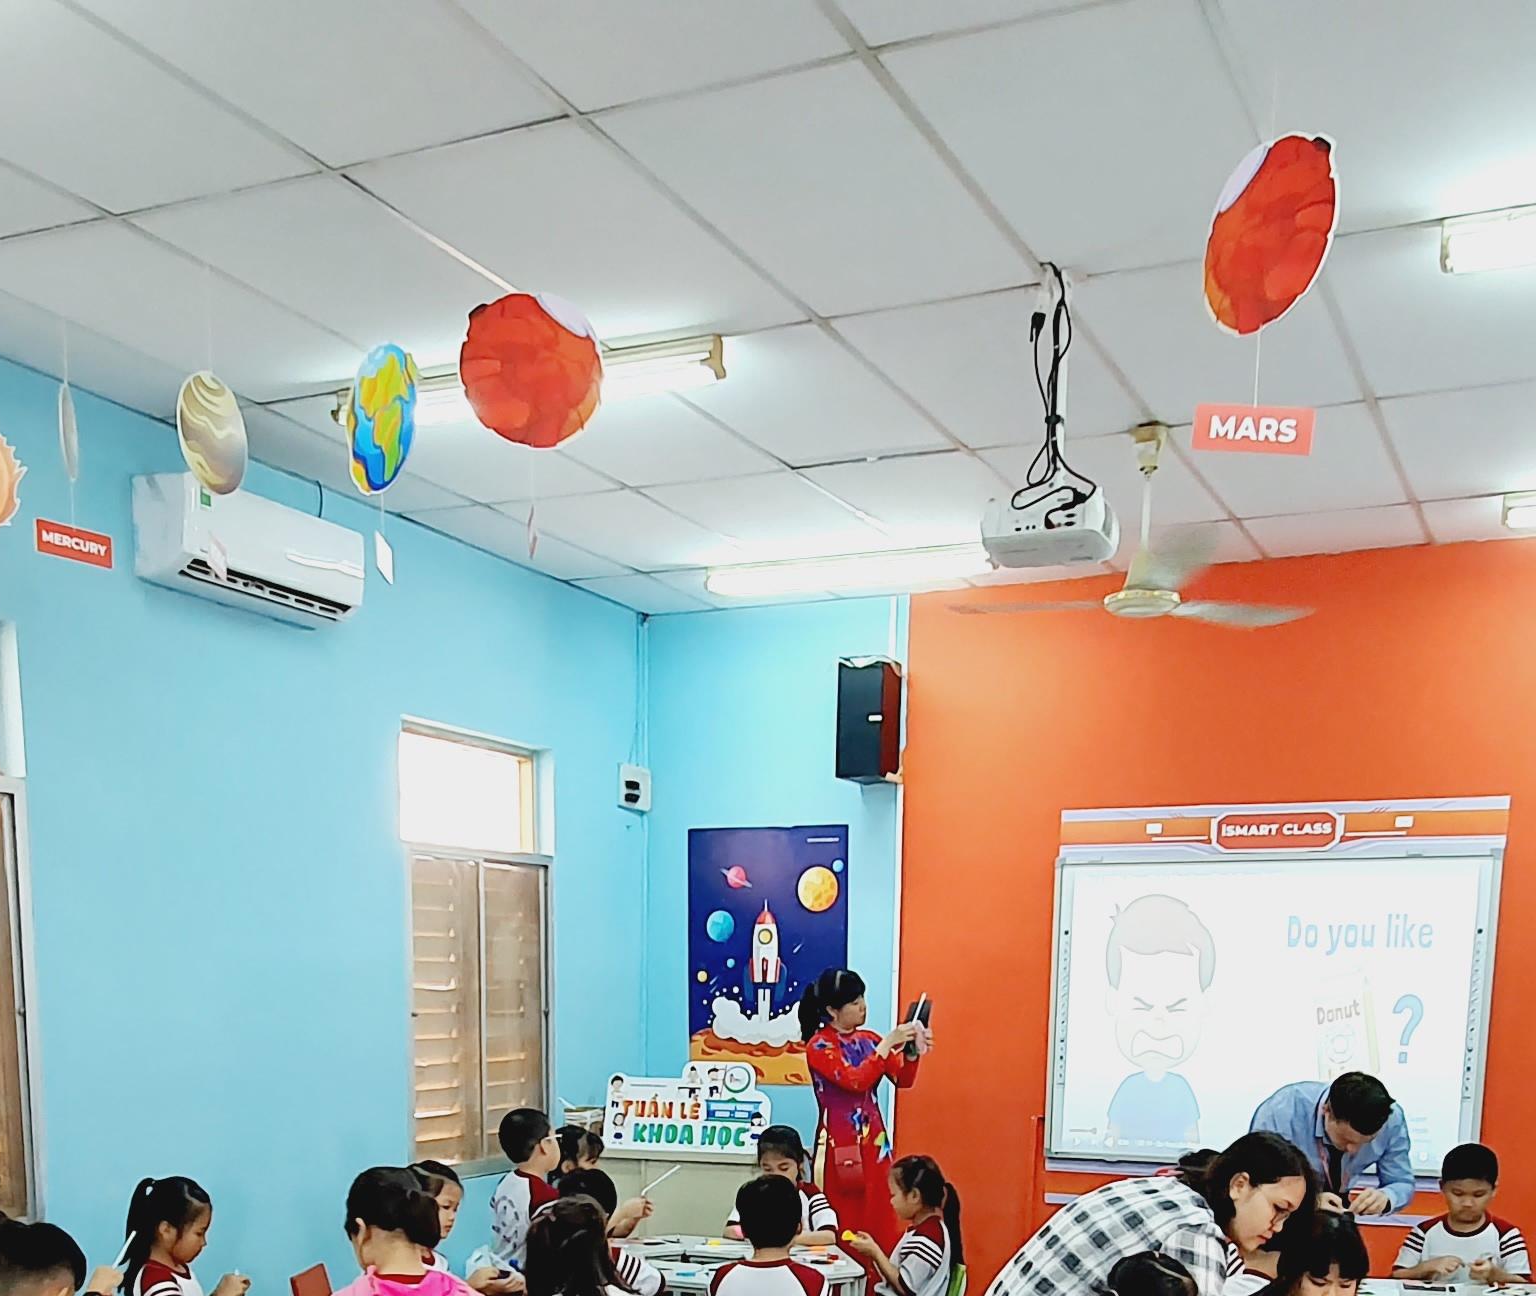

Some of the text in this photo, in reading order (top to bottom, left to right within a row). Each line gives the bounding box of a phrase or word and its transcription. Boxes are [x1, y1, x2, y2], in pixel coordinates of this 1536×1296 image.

[1209, 415, 1298, 443] MARS
[41, 529, 108, 557] MERCURY
[1282, 822, 1333, 835] CLASS
[1287, 913, 1434, 956] Do you like
[1316, 999, 1361, 1025] Donut
[1392, 994, 1425, 1064] ?
[633, 1122, 748, 1150] KHOA HỌC
